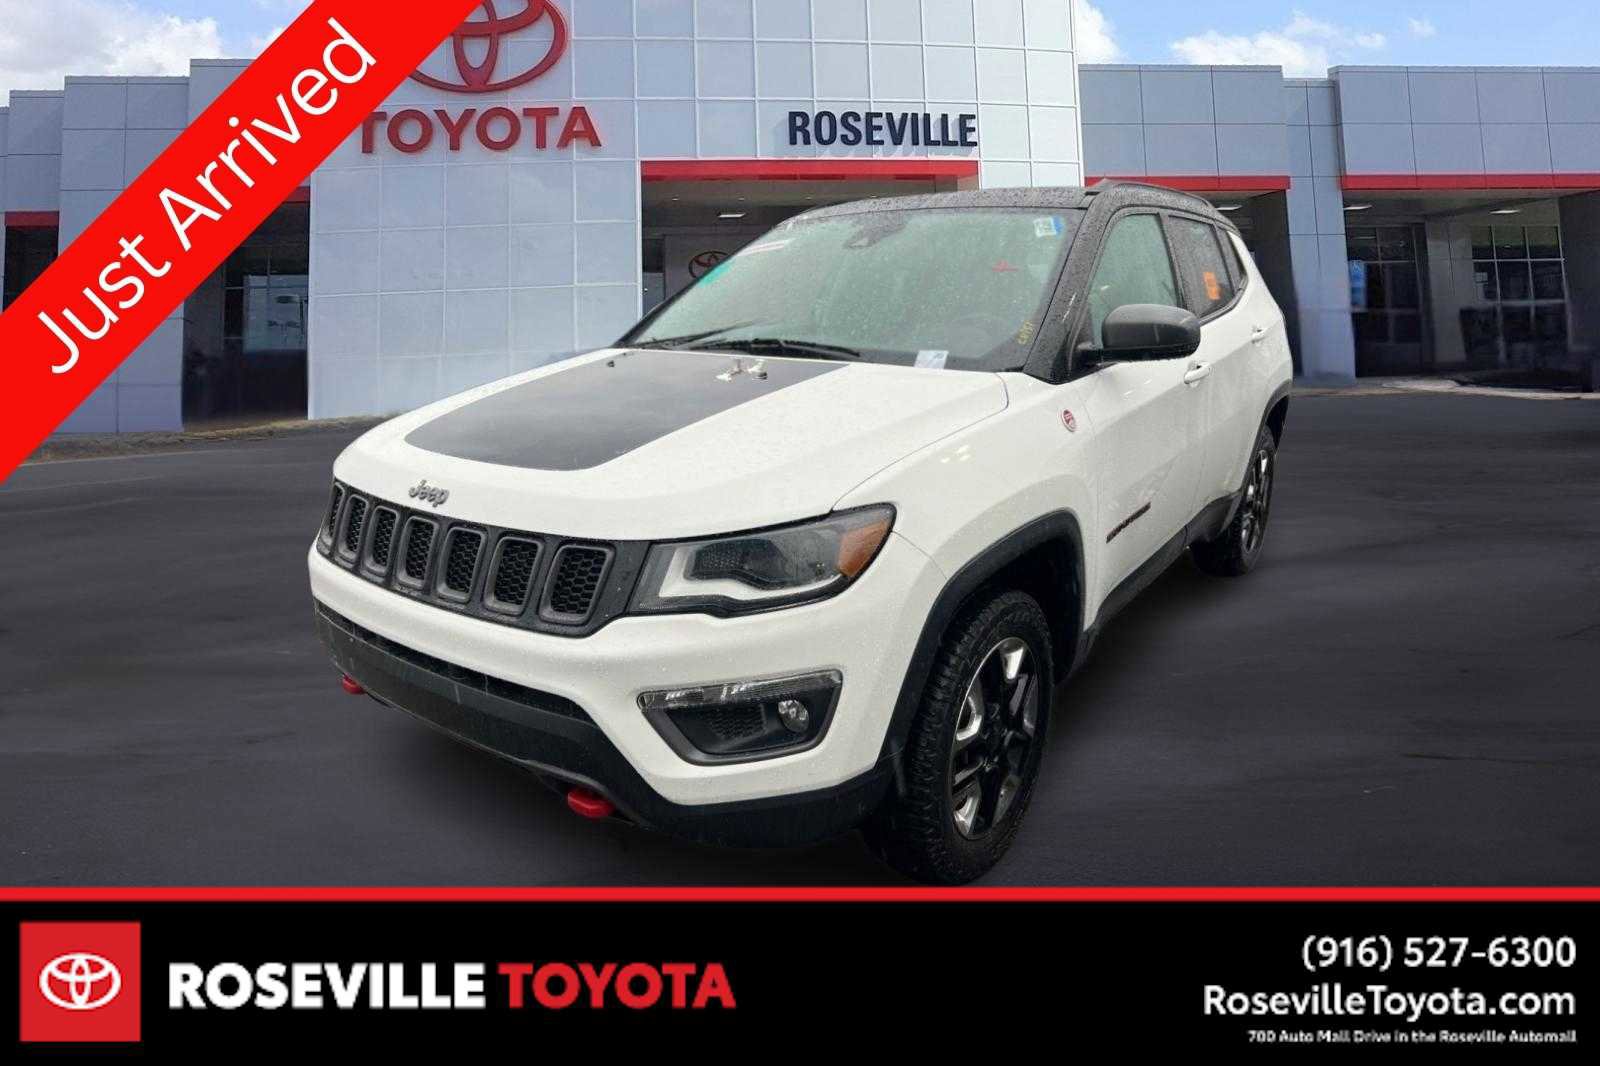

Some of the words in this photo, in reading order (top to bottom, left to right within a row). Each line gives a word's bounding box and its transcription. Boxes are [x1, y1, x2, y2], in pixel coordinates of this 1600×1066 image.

[360, 106, 602, 154] TOYOTA
[788, 111, 978, 147] ROSEVILLE
[408, 480, 449, 508] Jeep
